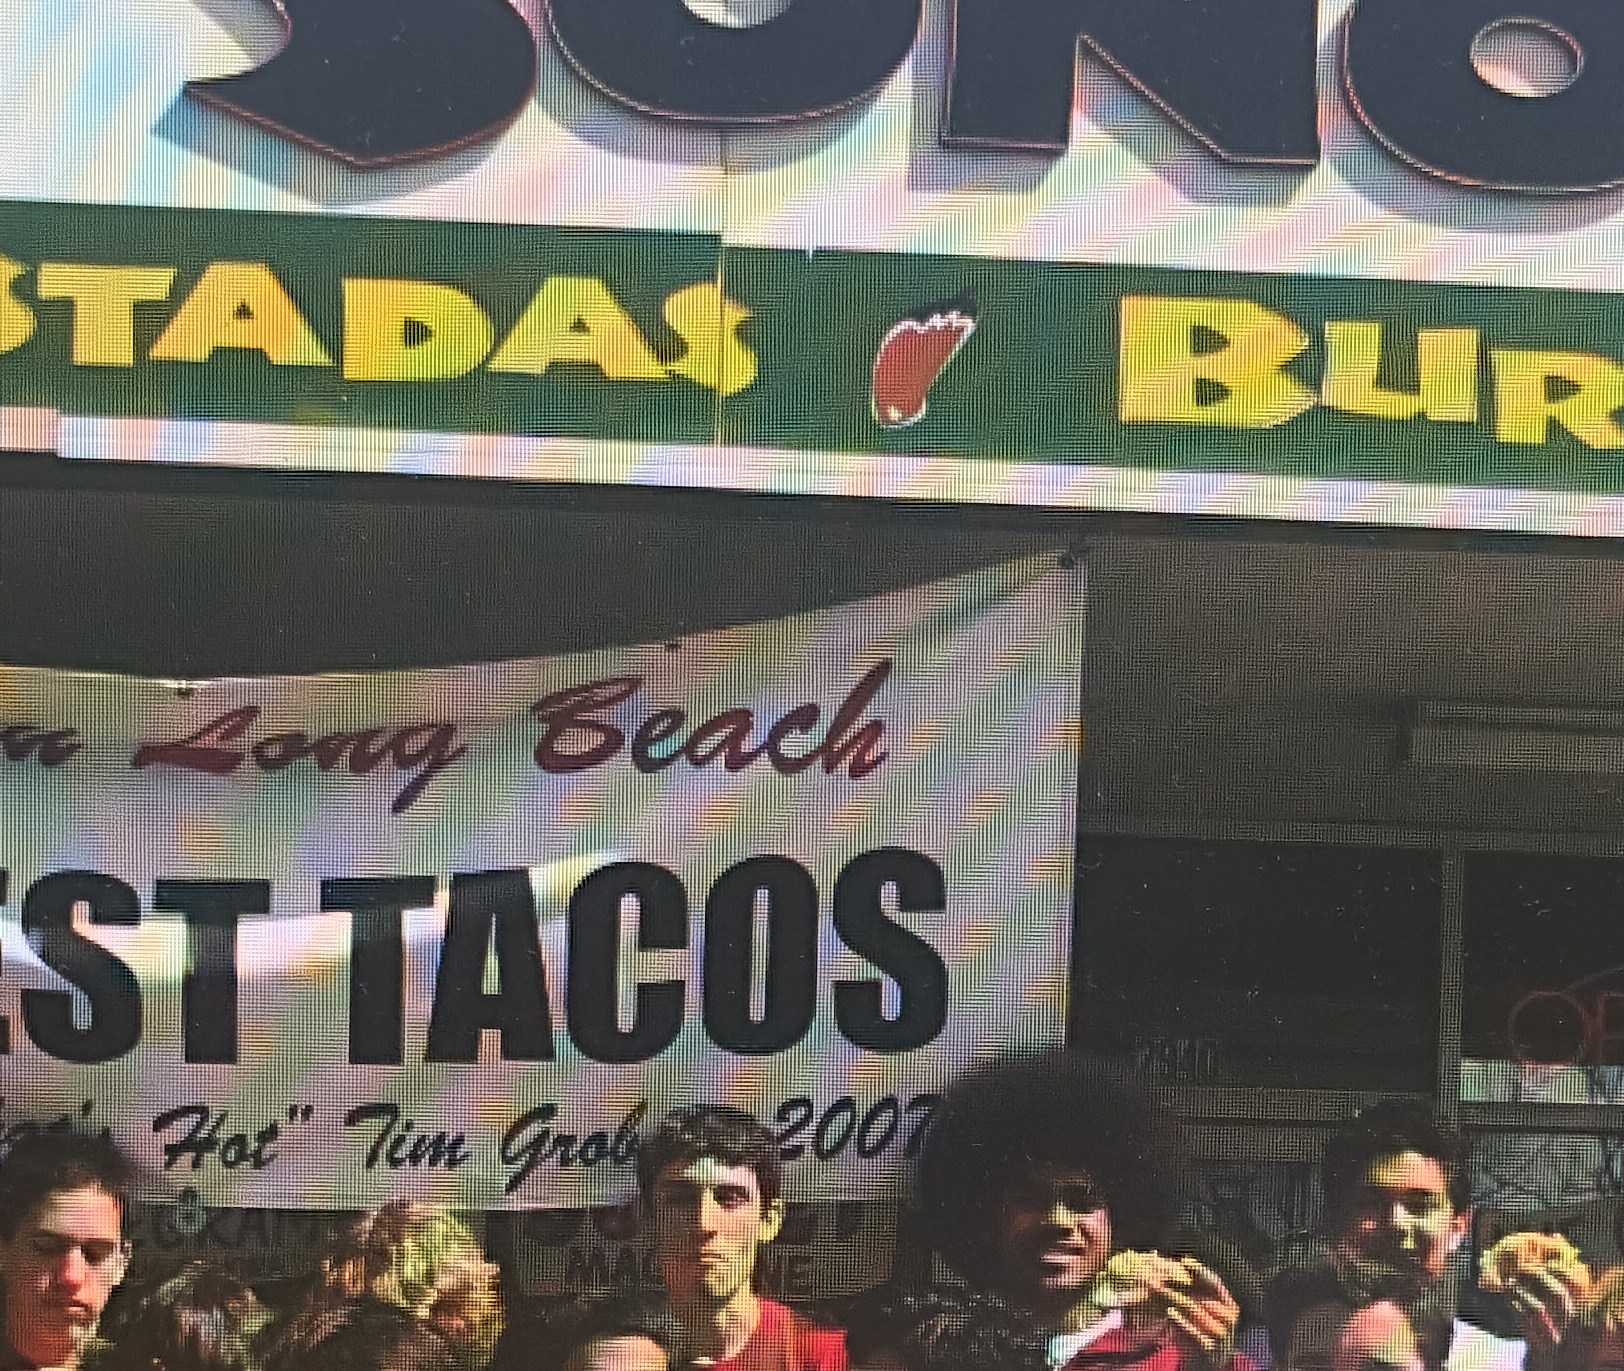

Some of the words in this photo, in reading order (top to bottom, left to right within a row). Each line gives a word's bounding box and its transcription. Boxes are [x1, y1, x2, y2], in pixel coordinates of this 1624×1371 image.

[132, 704, 469, 813] Long
[531, 659, 891, 780] Beach
[320, 845, 949, 1065] TACOS
[346, 1104, 470, 1171] Tim
[503, 1100, 645, 1192] Grob
[775, 1093, 945, 1162] 2007
